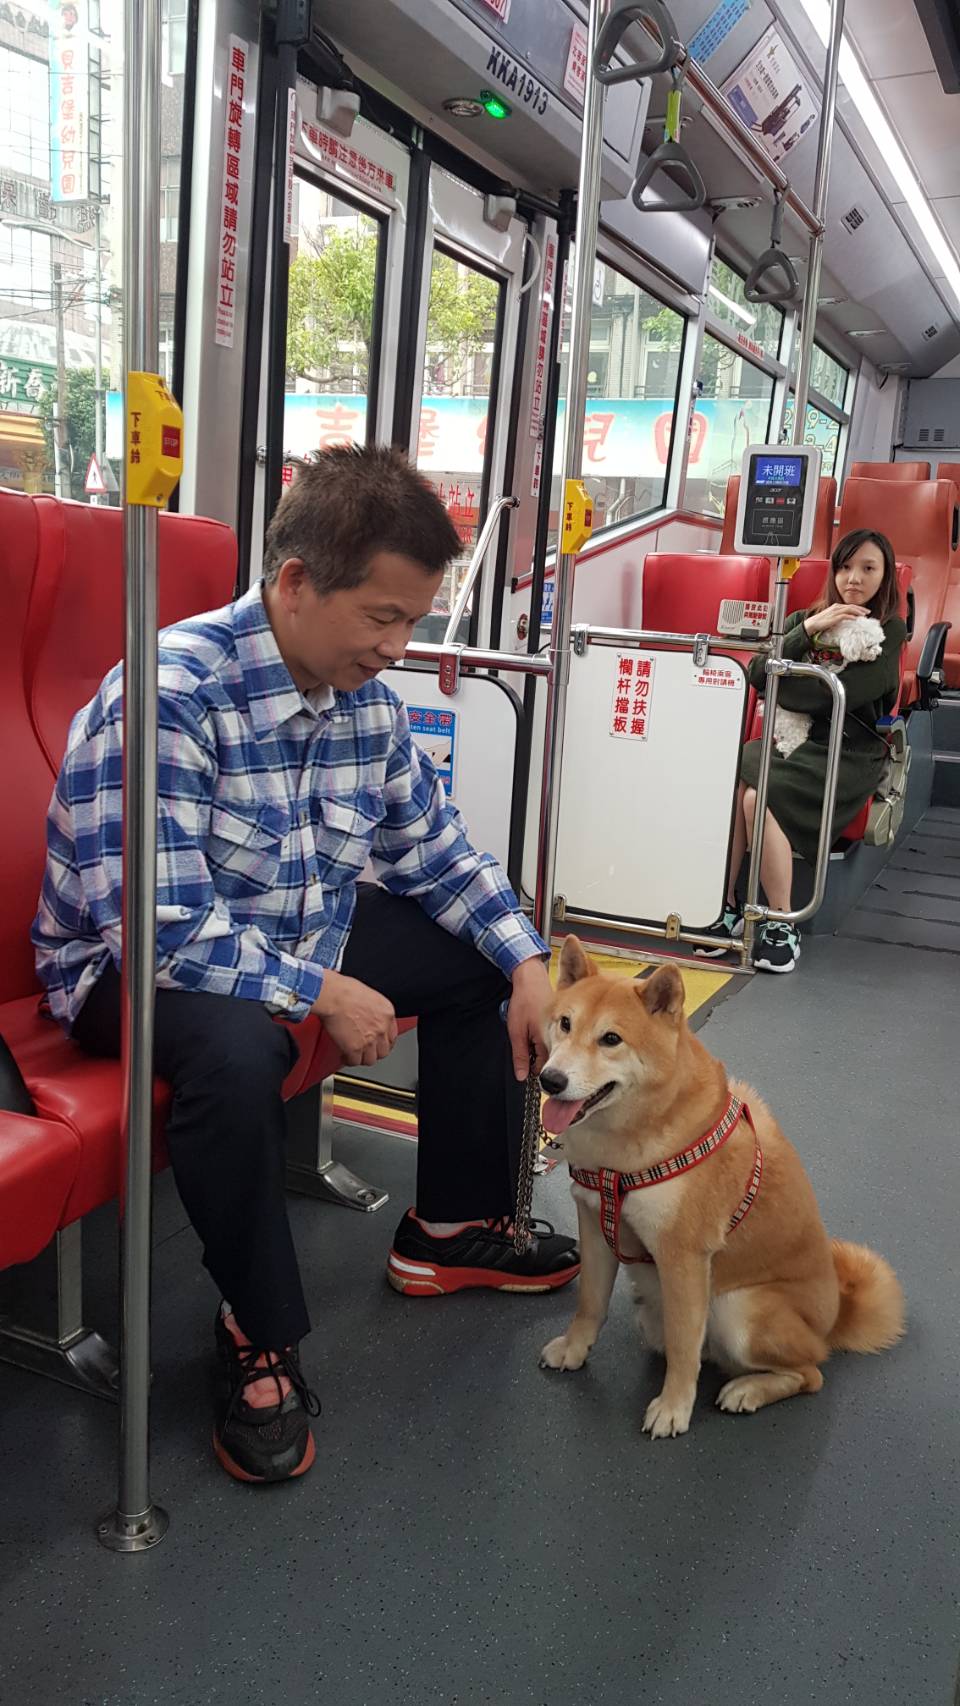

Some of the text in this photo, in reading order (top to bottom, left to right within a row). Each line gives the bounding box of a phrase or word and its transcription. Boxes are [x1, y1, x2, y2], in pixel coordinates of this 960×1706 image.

[486, 46, 549, 115] KKA1913
[219, 46, 246, 308] 車門旋轉區域請勿站立
[130, 412, 142, 464] 下車鈴
[762, 464, 797, 477] 未開班
[613, 658, 634, 734] 欄杆擋板
[630, 660, 652, 735] 請勿扶握
